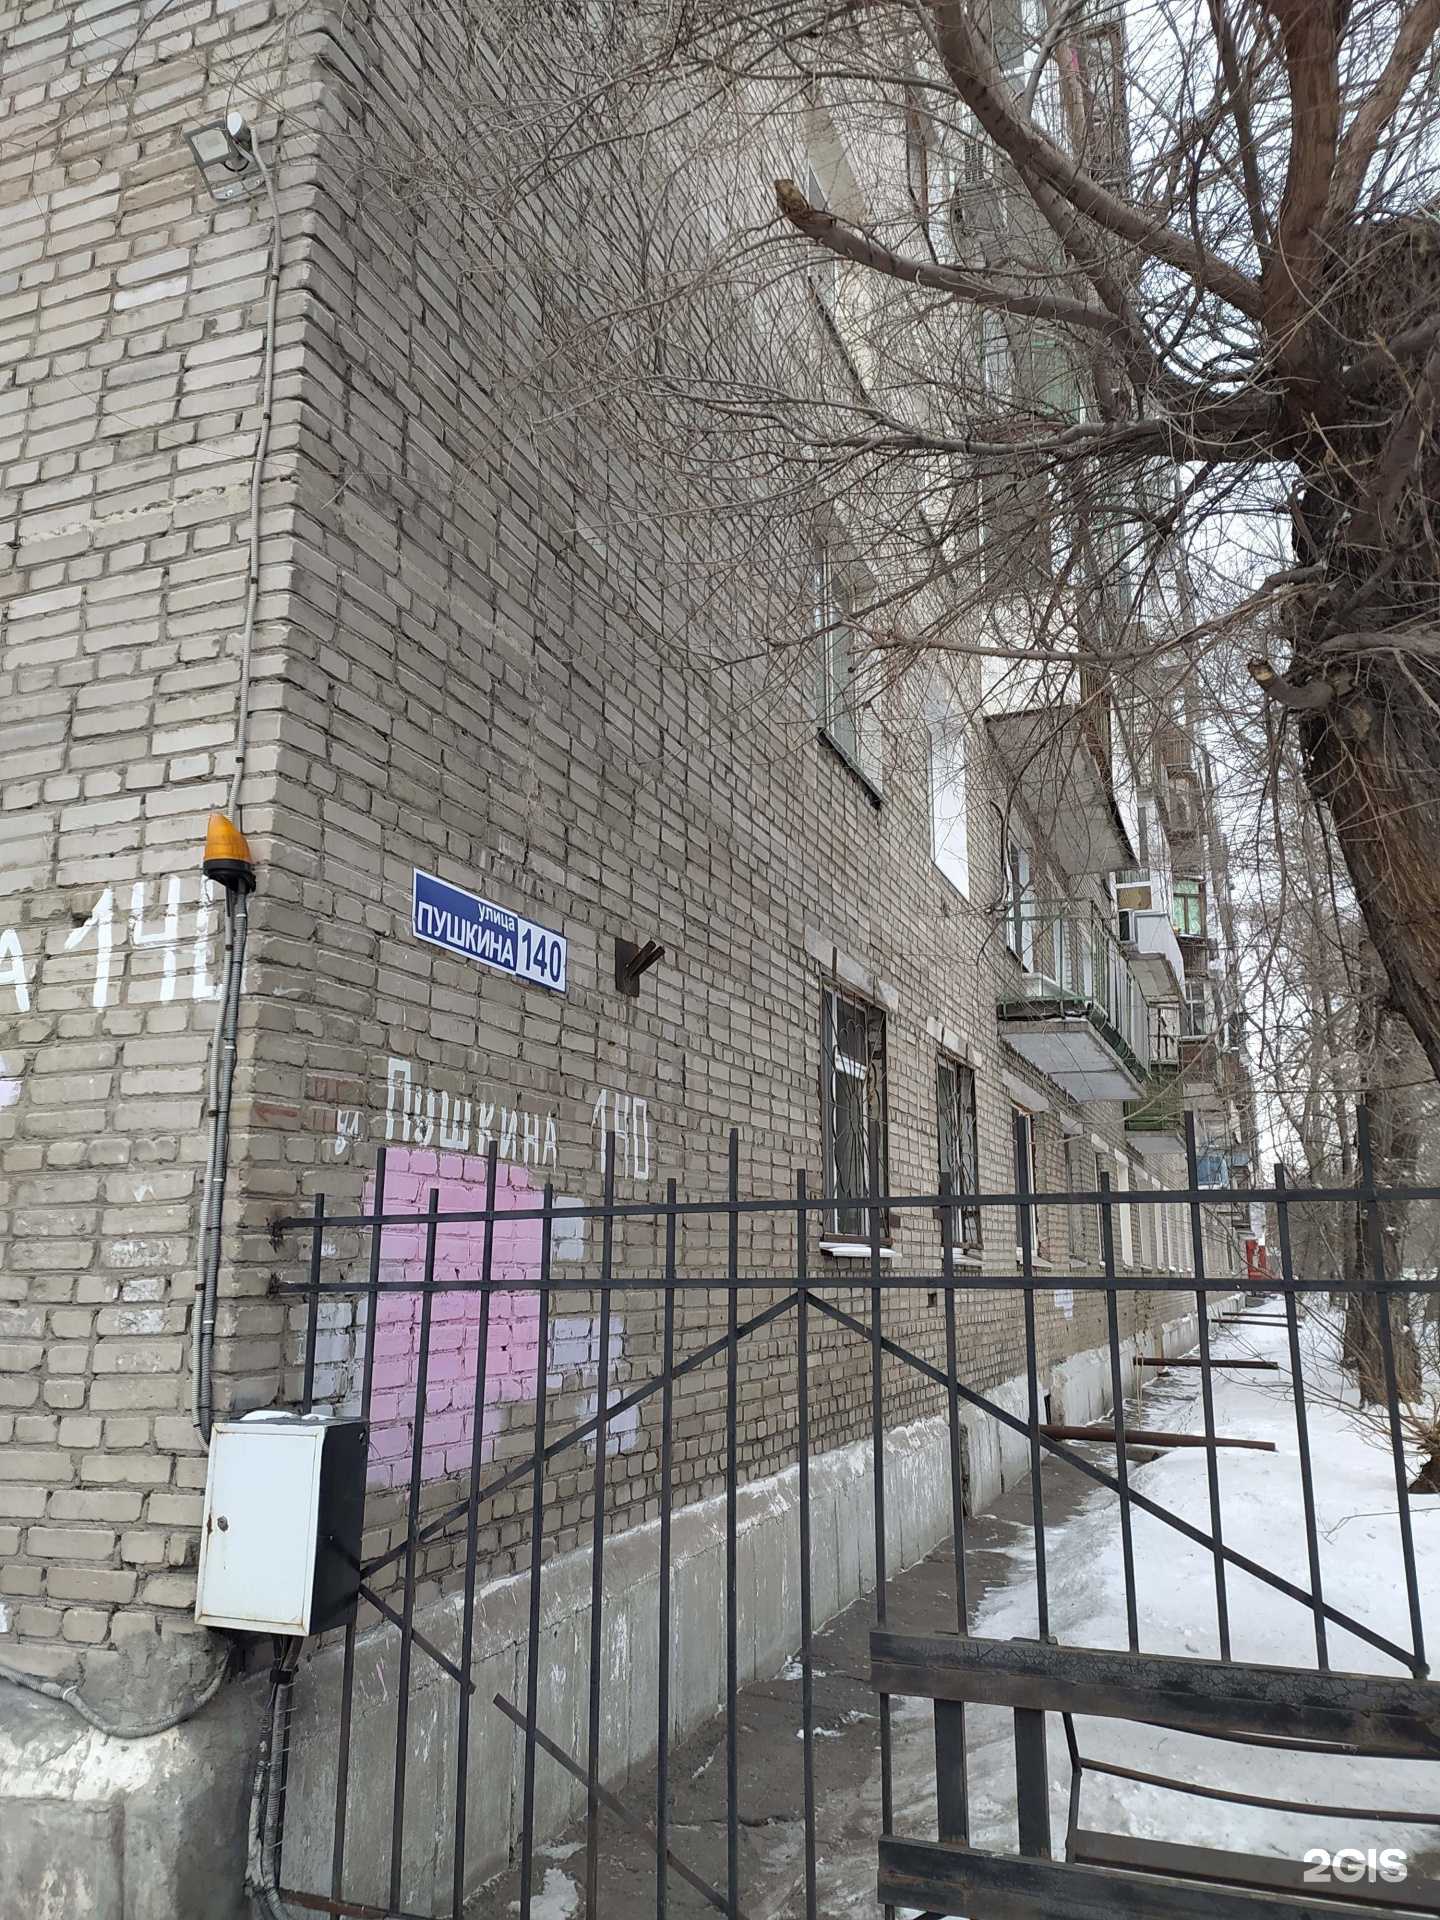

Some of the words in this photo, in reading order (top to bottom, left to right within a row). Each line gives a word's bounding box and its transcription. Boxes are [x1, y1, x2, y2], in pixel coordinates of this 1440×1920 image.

[417, 901, 514, 968] ПУШКИНА
[478, 902, 515, 932] улица
[522, 928, 562, 984] 140
[591, 1088, 649, 1181] 140
